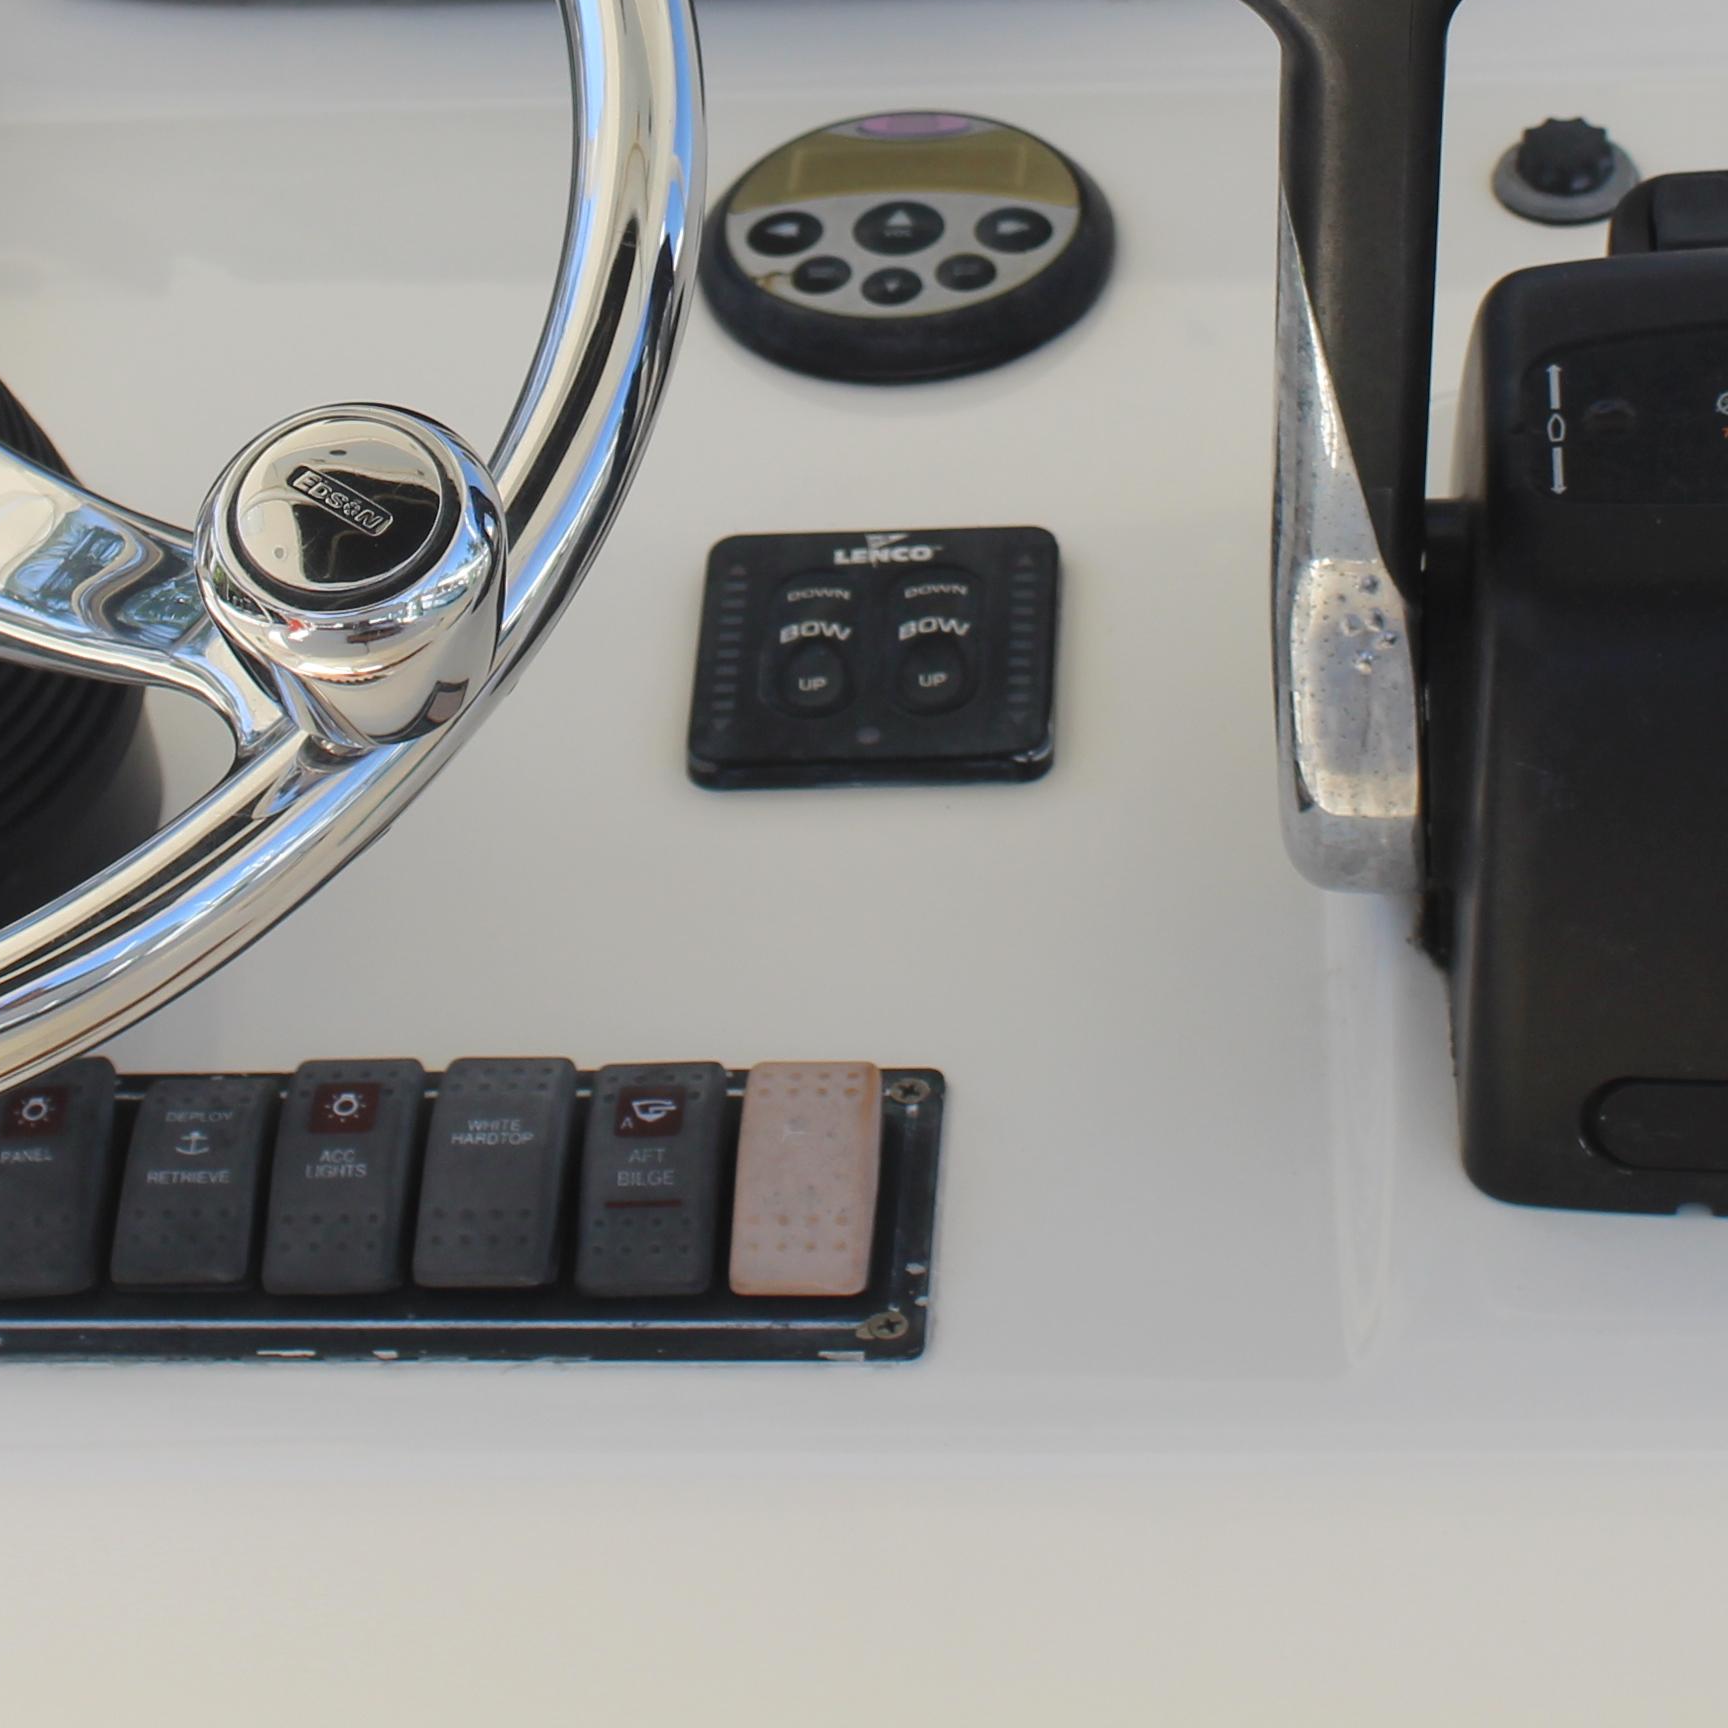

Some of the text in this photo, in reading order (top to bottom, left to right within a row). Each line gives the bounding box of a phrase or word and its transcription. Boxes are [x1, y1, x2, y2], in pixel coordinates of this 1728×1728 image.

[292, 471, 383, 529] EDSON
[833, 545, 932, 565] LENCO
[787, 586, 852, 602] DOWN
[904, 582, 969, 599] DOWN
[779, 620, 852, 644] BOW
[898, 616, 971, 641] BOW
[798, 676, 827, 691] UP
[918, 672, 947, 688] UP
[165, 1111, 233, 1123] DEPLOY
[467, 1119, 521, 1132] WHITE
[451, 1132, 535, 1146] HARDTOP
[0, 1149, 54, 1165] PANEL
[319, 1150, 356, 1163] ACC
[628, 1148, 666, 1163] AFT
[146, 1171, 231, 1184] RETRIEVE
[305, 1163, 368, 1178] LIGHTS
[616, 1172, 674, 1186] BILGE
